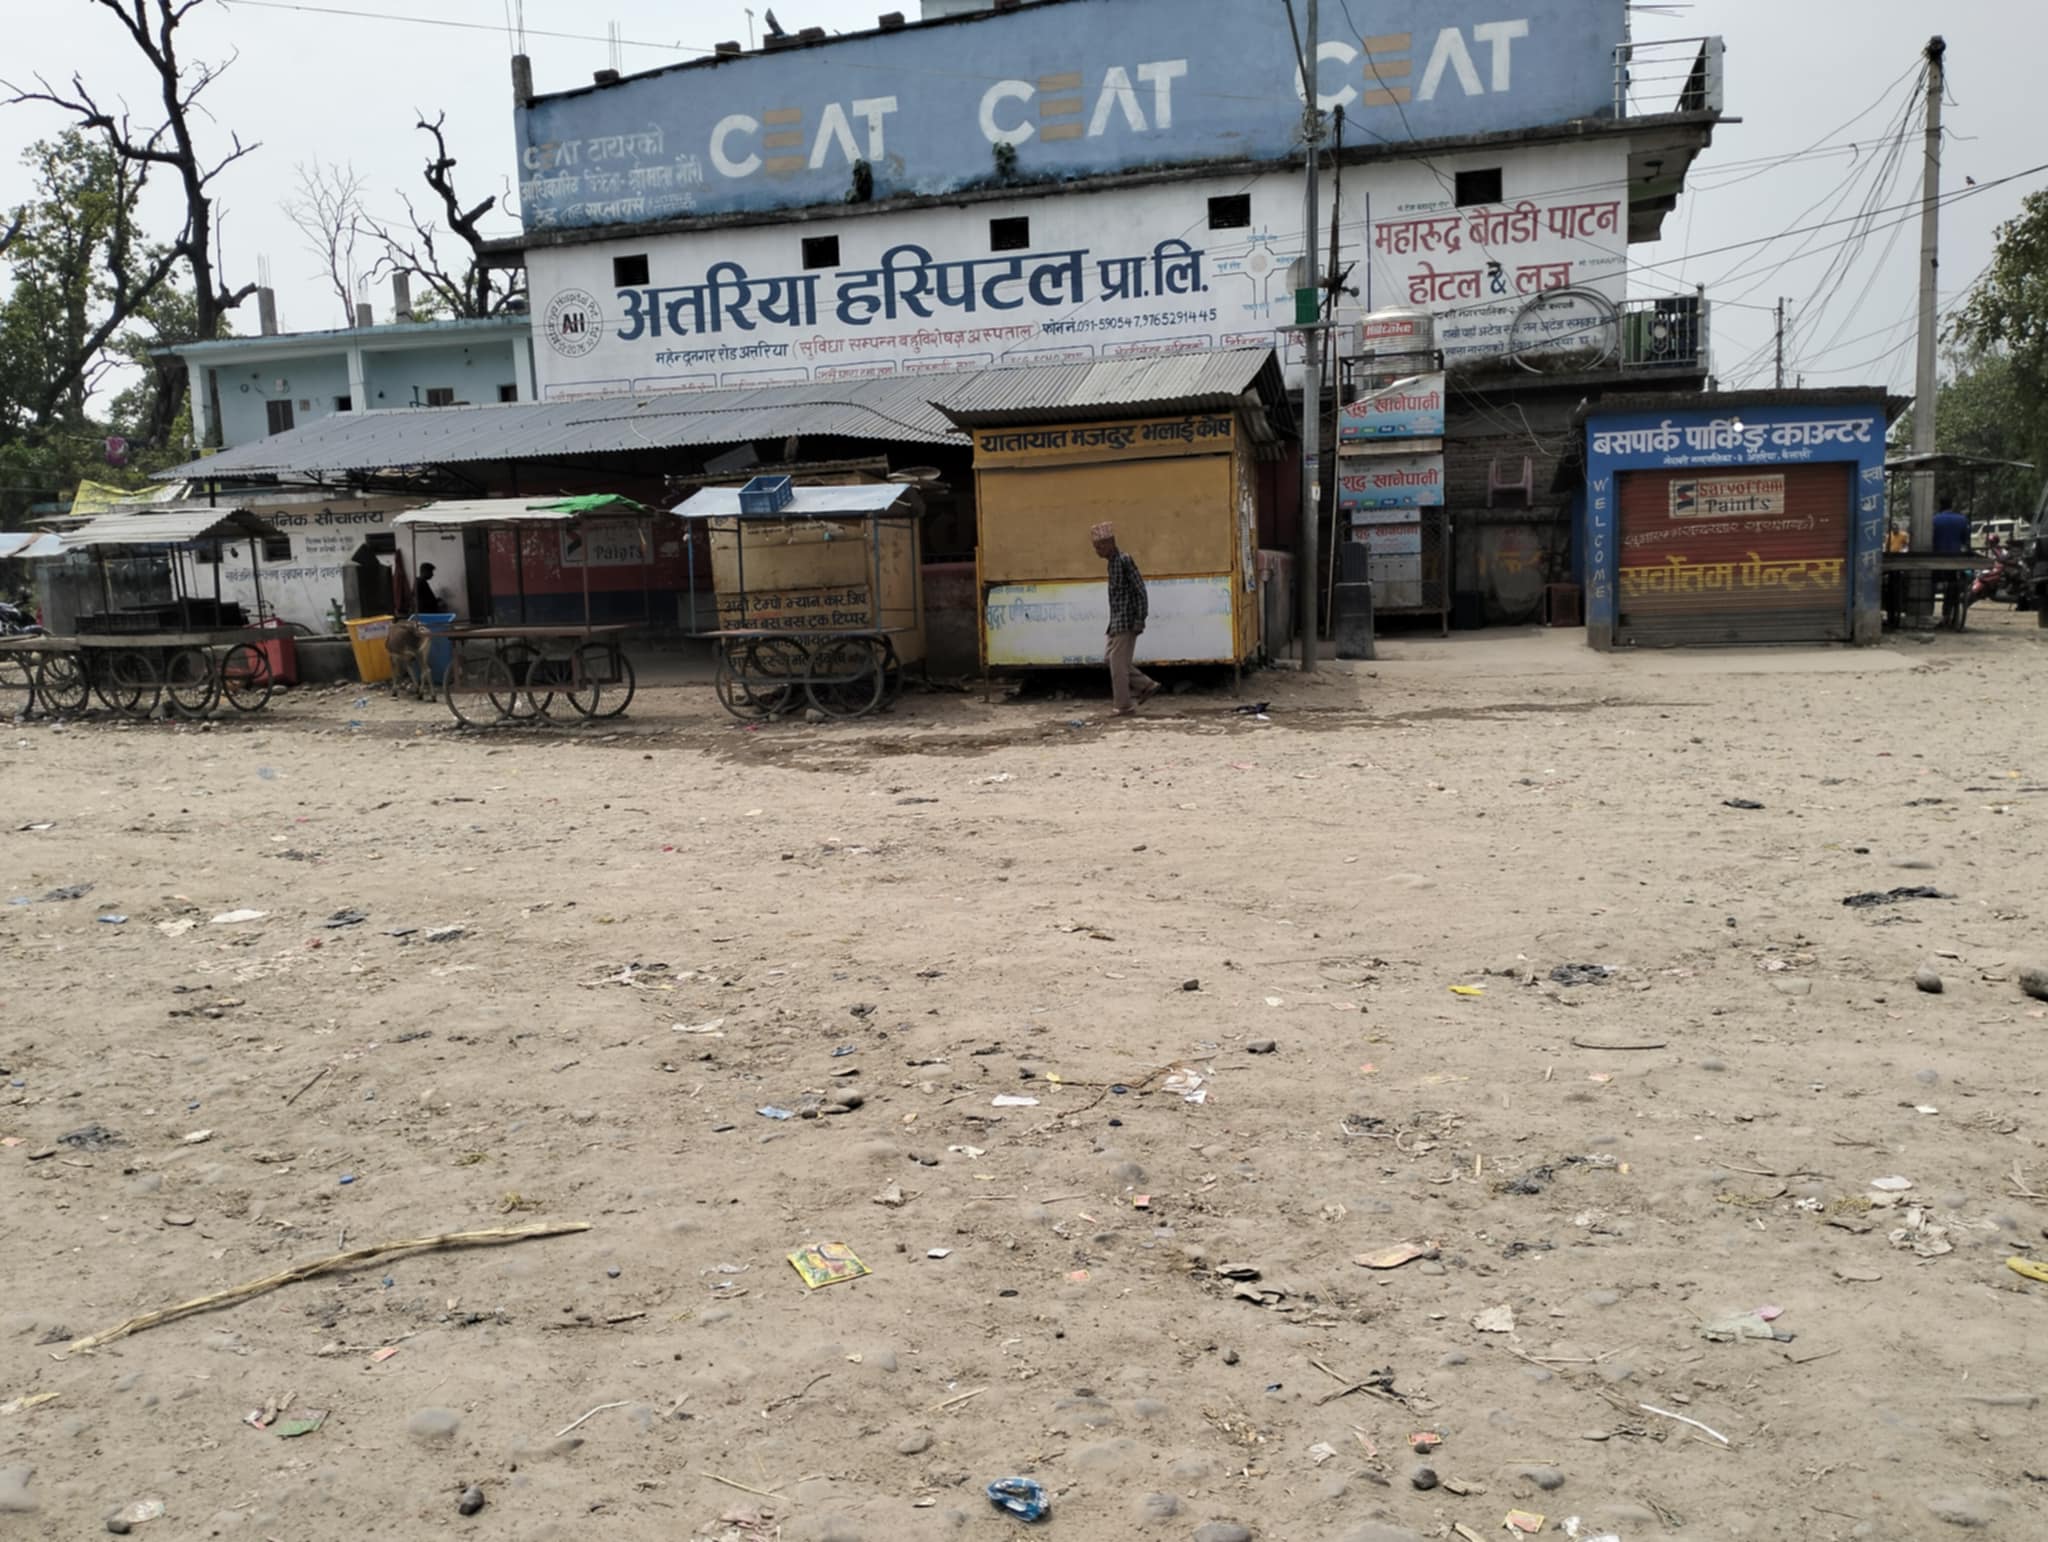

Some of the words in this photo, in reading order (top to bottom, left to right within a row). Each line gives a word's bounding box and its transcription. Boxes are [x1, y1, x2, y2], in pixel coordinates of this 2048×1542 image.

[1294, 19, 1528, 112] CEAT
[979, 59, 1188, 144] CEAT
[523, 140, 582, 169] CEAT
[709, 95, 897, 178] CEAT
[1548, 201, 1620, 239] पाटन
[1408, 261, 1482, 304] होटल
[1375, 392, 1440, 412] खानेपानी
[981, 431, 1067, 452] यातायात
[1142, 416, 1194, 442] भलाई
[1195, 415, 1232, 437] कोष
[1593, 420, 1681, 455] बसपार्क
[1771, 418, 1874, 446] काउन्टर
[1374, 468, 1438, 487] खानेपानी
[1705, 496, 1770, 513] Paints
[1593, 477, 1609, 599] WELCOME
